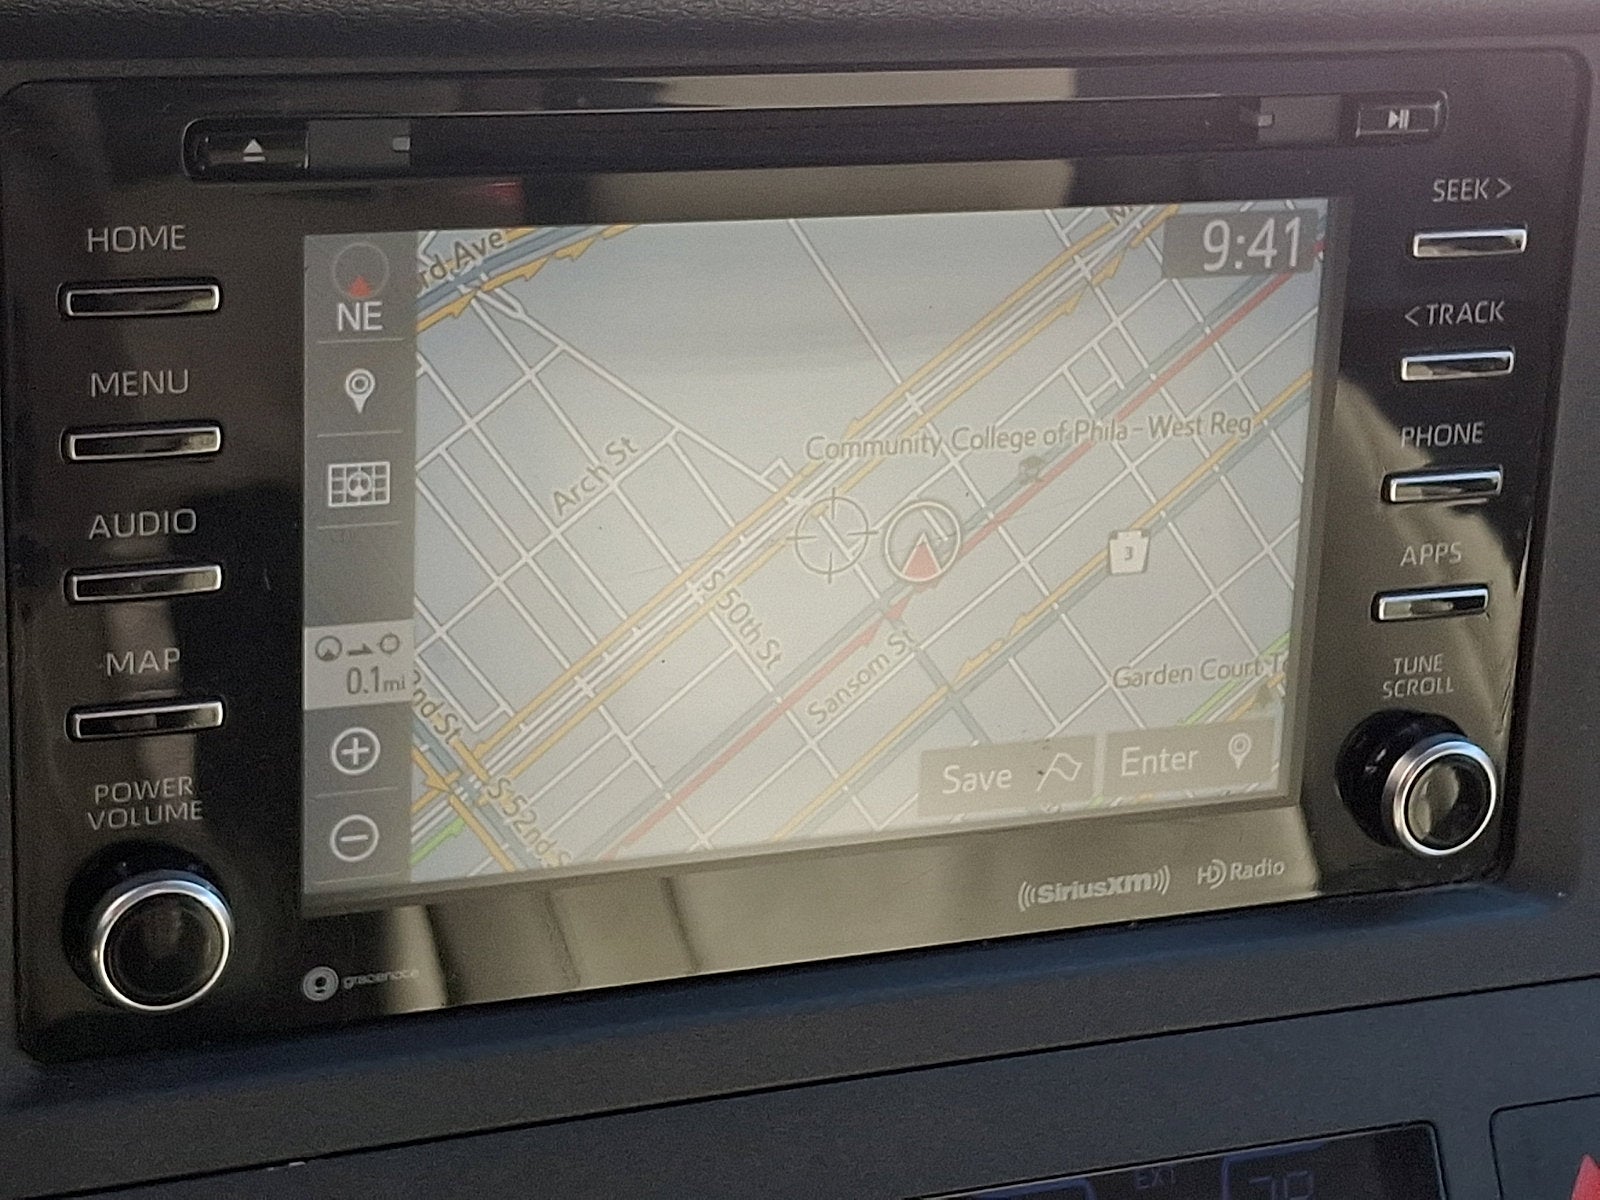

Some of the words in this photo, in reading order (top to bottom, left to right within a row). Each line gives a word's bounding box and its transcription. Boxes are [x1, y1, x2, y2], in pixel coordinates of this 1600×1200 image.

[87, 224, 187, 253] HOME
[452, 230, 505, 270] Ave
[1203, 216, 1301, 271] 9:41
[337, 301, 384, 331] NE
[90, 368, 189, 398] MENU
[806, 435, 943, 458] Community
[952, 424, 1037, 453] College
[1043, 419, 1068, 443] of
[1211, 411, 1252, 439] Reg
[1400, 421, 1485, 449] PHONE
[553, 465, 611, 516] Arch
[605, 437, 638, 466] St
[88, 508, 197, 540] AUDIO
[1400, 542, 1462, 567] APPS
[702, 569, 725, 592] S
[716, 588, 763, 645] 50th
[756, 639, 782, 670] St
[105, 648, 181, 677] MAP
[807, 653, 890, 725] Sansom
[887, 629, 915, 656] St
[1112, 662, 1193, 689] Garden
[1200, 657, 1263, 681] Court
[1394, 653, 1443, 676] TUNE
[1382, 675, 1454, 699] SCROLL
[433, 713, 463, 744] St
[1121, 746, 1198, 776] Enter
[95, 777, 194, 804] POWER
[942, 764, 1012, 795] Save
[87, 801, 204, 831] VOLUME
[487, 777, 511, 798] S
[502, 794, 557, 855] 52nd
[1230, 858, 1285, 881] Radio
